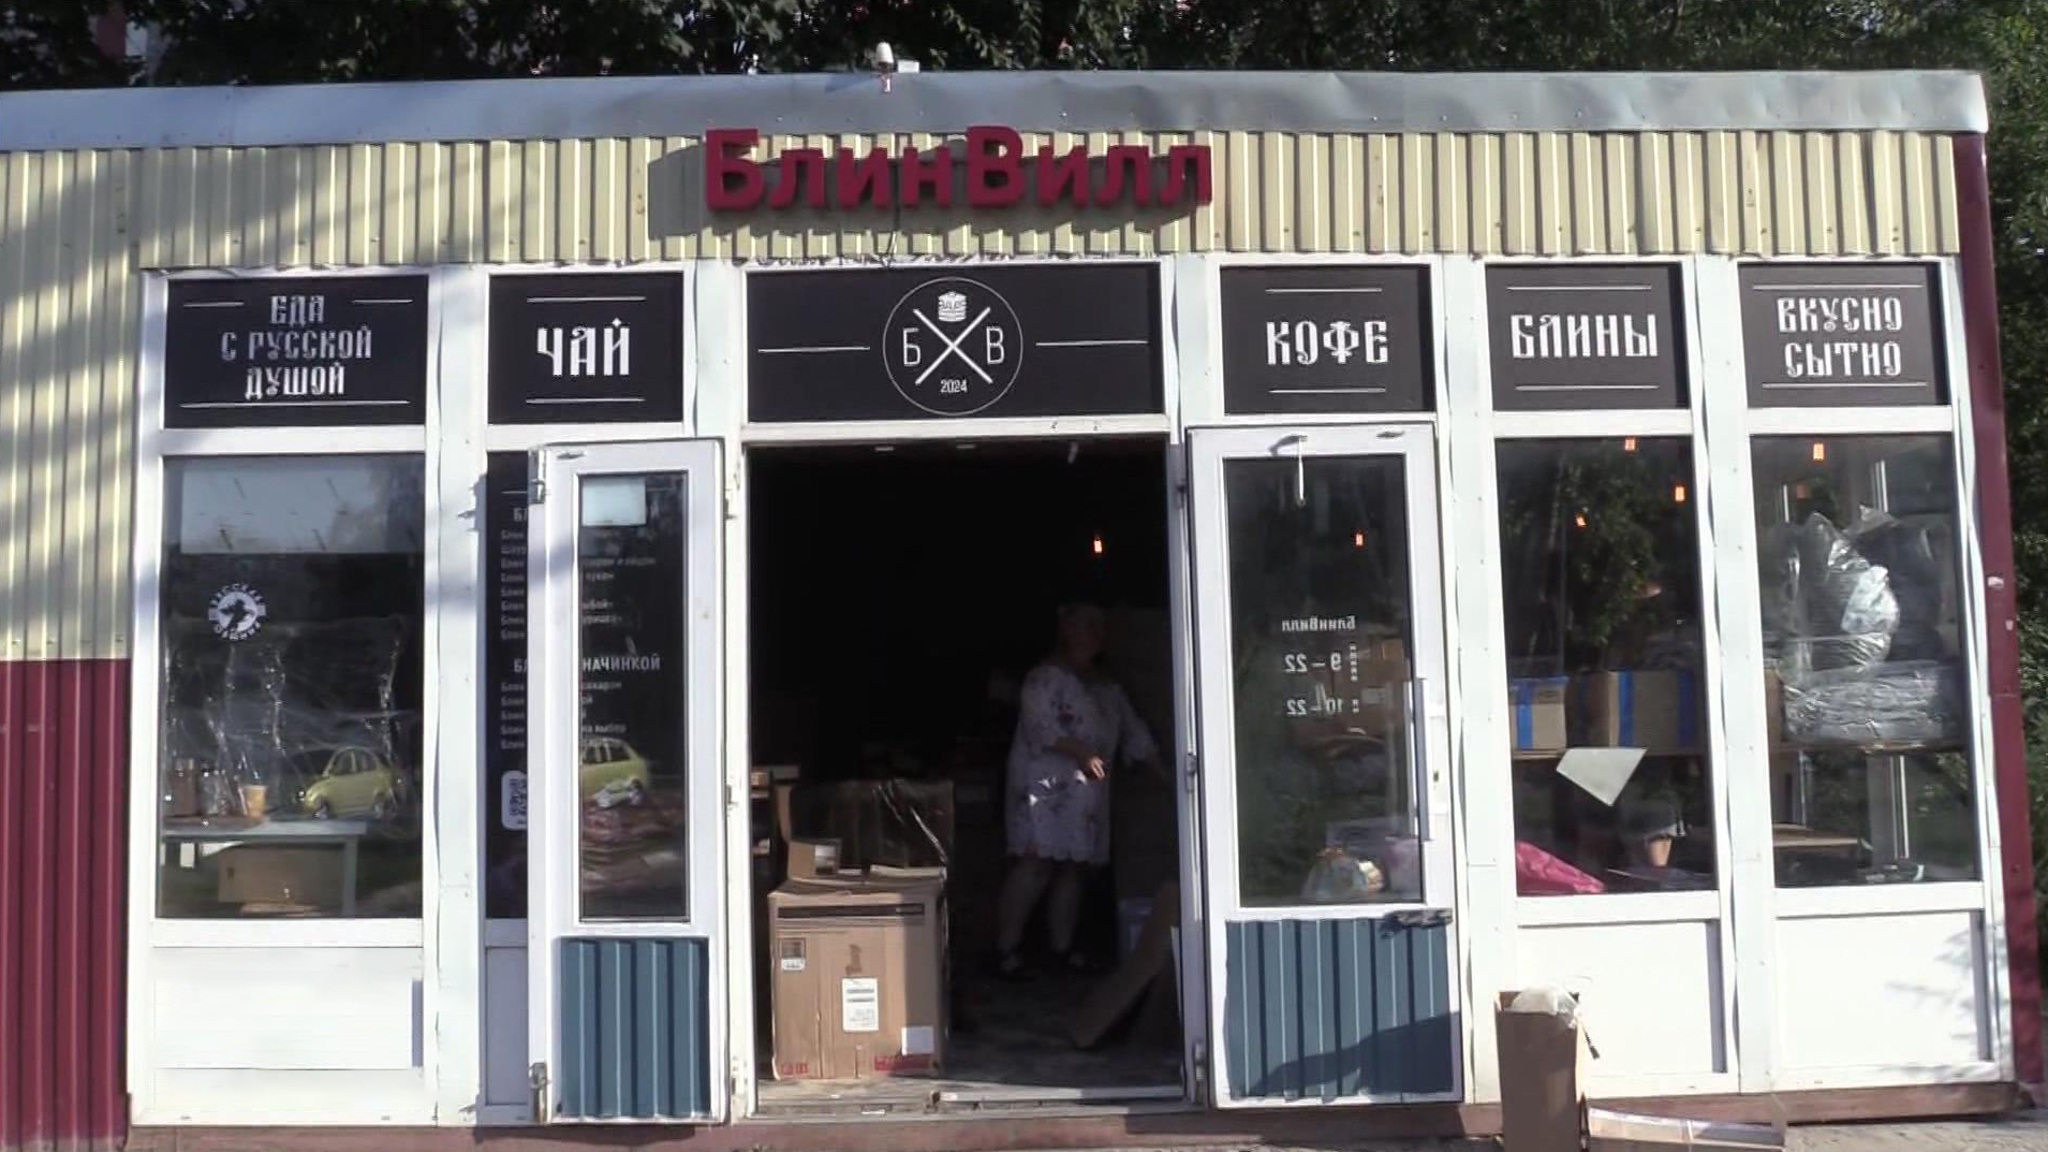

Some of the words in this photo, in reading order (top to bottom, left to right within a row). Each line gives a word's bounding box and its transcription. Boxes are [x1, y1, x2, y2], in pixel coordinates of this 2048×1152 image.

[705, 125, 1213, 213] БлинВилл
[270, 295, 324, 325] ЕДА
[1777, 296, 1903, 334] ВКУСНО
[220, 331, 237, 361] С
[248, 326, 373, 361] РУССКОЙ
[536, 317, 631, 377] ЧАЙ
[902, 327, 921, 366] Б
[985, 326, 1005, 365] В
[1266, 320, 1389, 366] КОФЕ
[1510, 314, 1658, 359] БЛИНЫ
[1784, 340, 1902, 377] СЫТНО
[244, 362, 346, 401] ДУШОЙ
[940, 379, 968, 394] 2024
[582, 654, 661, 671] НАЧИНКОЙ
